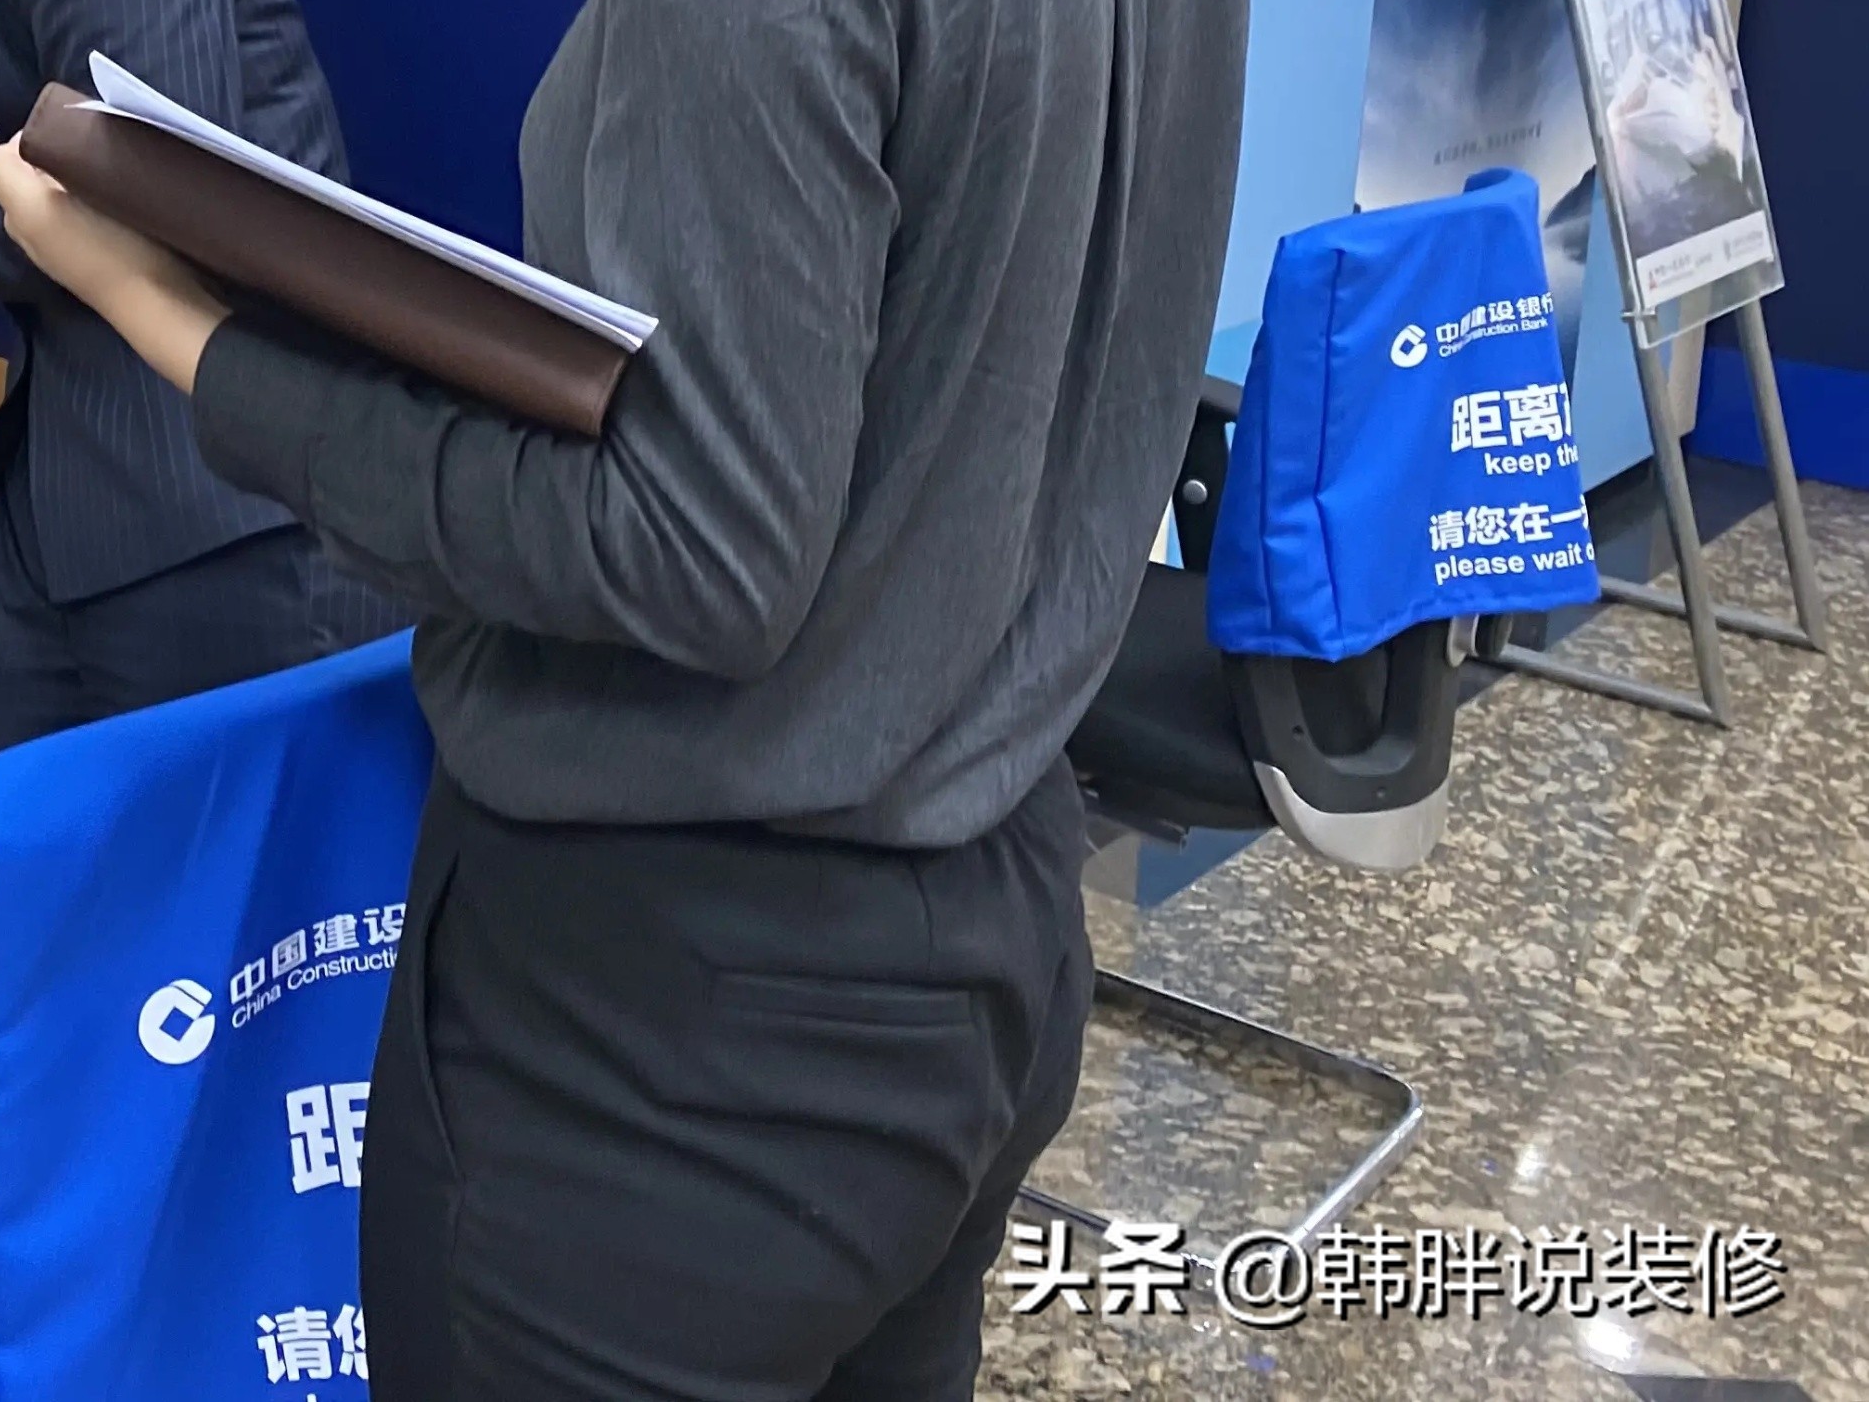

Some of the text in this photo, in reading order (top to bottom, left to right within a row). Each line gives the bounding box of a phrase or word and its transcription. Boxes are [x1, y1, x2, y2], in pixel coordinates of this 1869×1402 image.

[1521, 316, 1549, 331] Bank
[1484, 452, 1551, 476] keep
[1434, 554, 1525, 585] please
[1532, 543, 1583, 571] wait
[230, 903, 406, 1005] 中国建设
[232, 947, 397, 1029] China Constructi
